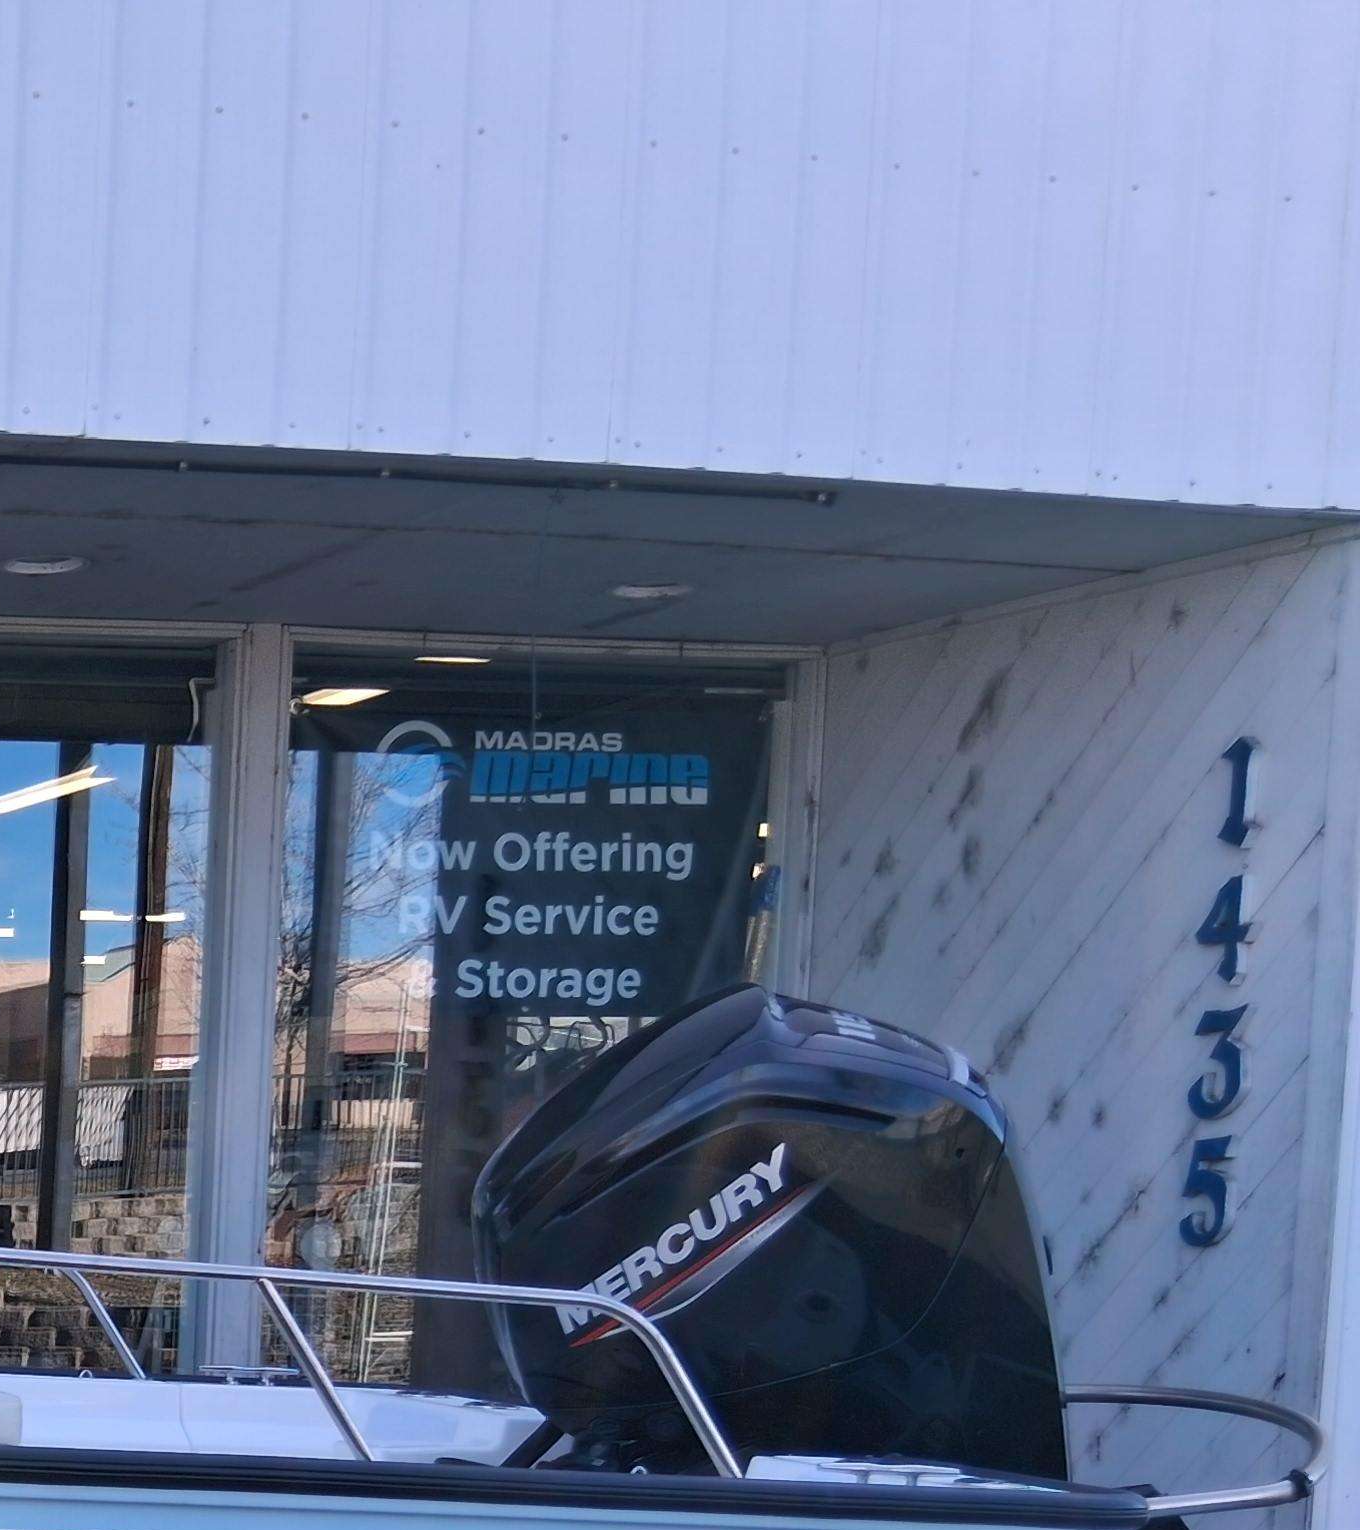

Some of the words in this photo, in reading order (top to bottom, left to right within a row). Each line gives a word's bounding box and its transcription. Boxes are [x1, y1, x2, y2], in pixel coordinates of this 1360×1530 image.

[474, 730, 624, 753] MADRAS
[469, 752, 710, 806] marine
[369, 832, 476, 873] Now
[493, 832, 694, 880] Offering
[398, 896, 466, 935] RV
[483, 895, 659, 936] Service
[454, 958, 641, 1006] Storage
[555, 1141, 788, 1336] MERCURY
